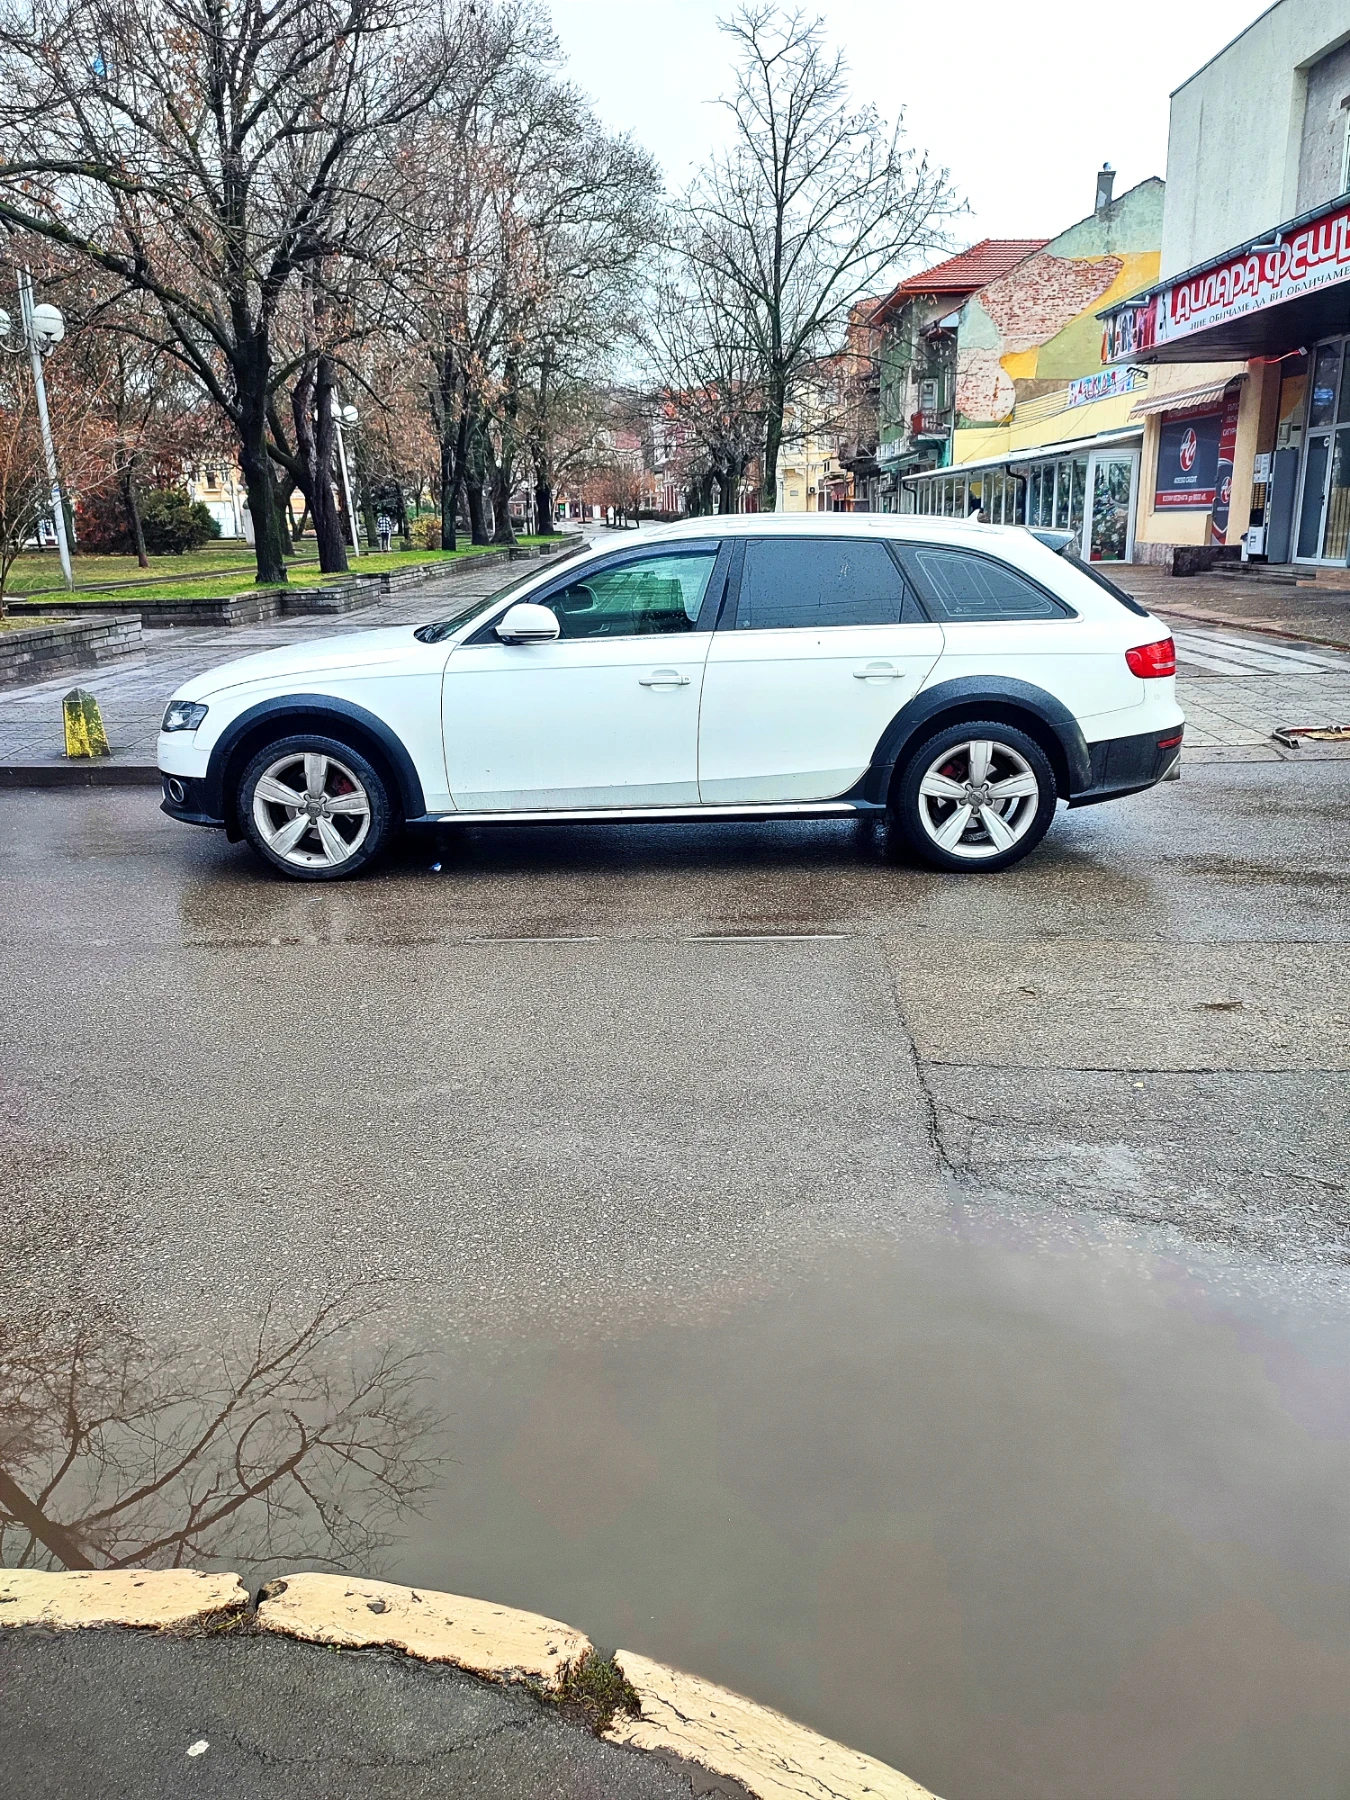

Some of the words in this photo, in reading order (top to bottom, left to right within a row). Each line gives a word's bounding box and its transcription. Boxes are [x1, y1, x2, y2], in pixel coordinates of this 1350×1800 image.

[1208, 301, 1251, 324] ОБИЧАМЕ
[1252, 297, 1266, 311] ДА
[1269, 289, 1284, 302] ВИ
[1286, 265, 1350, 296] ОБЛИЧАМЕ
